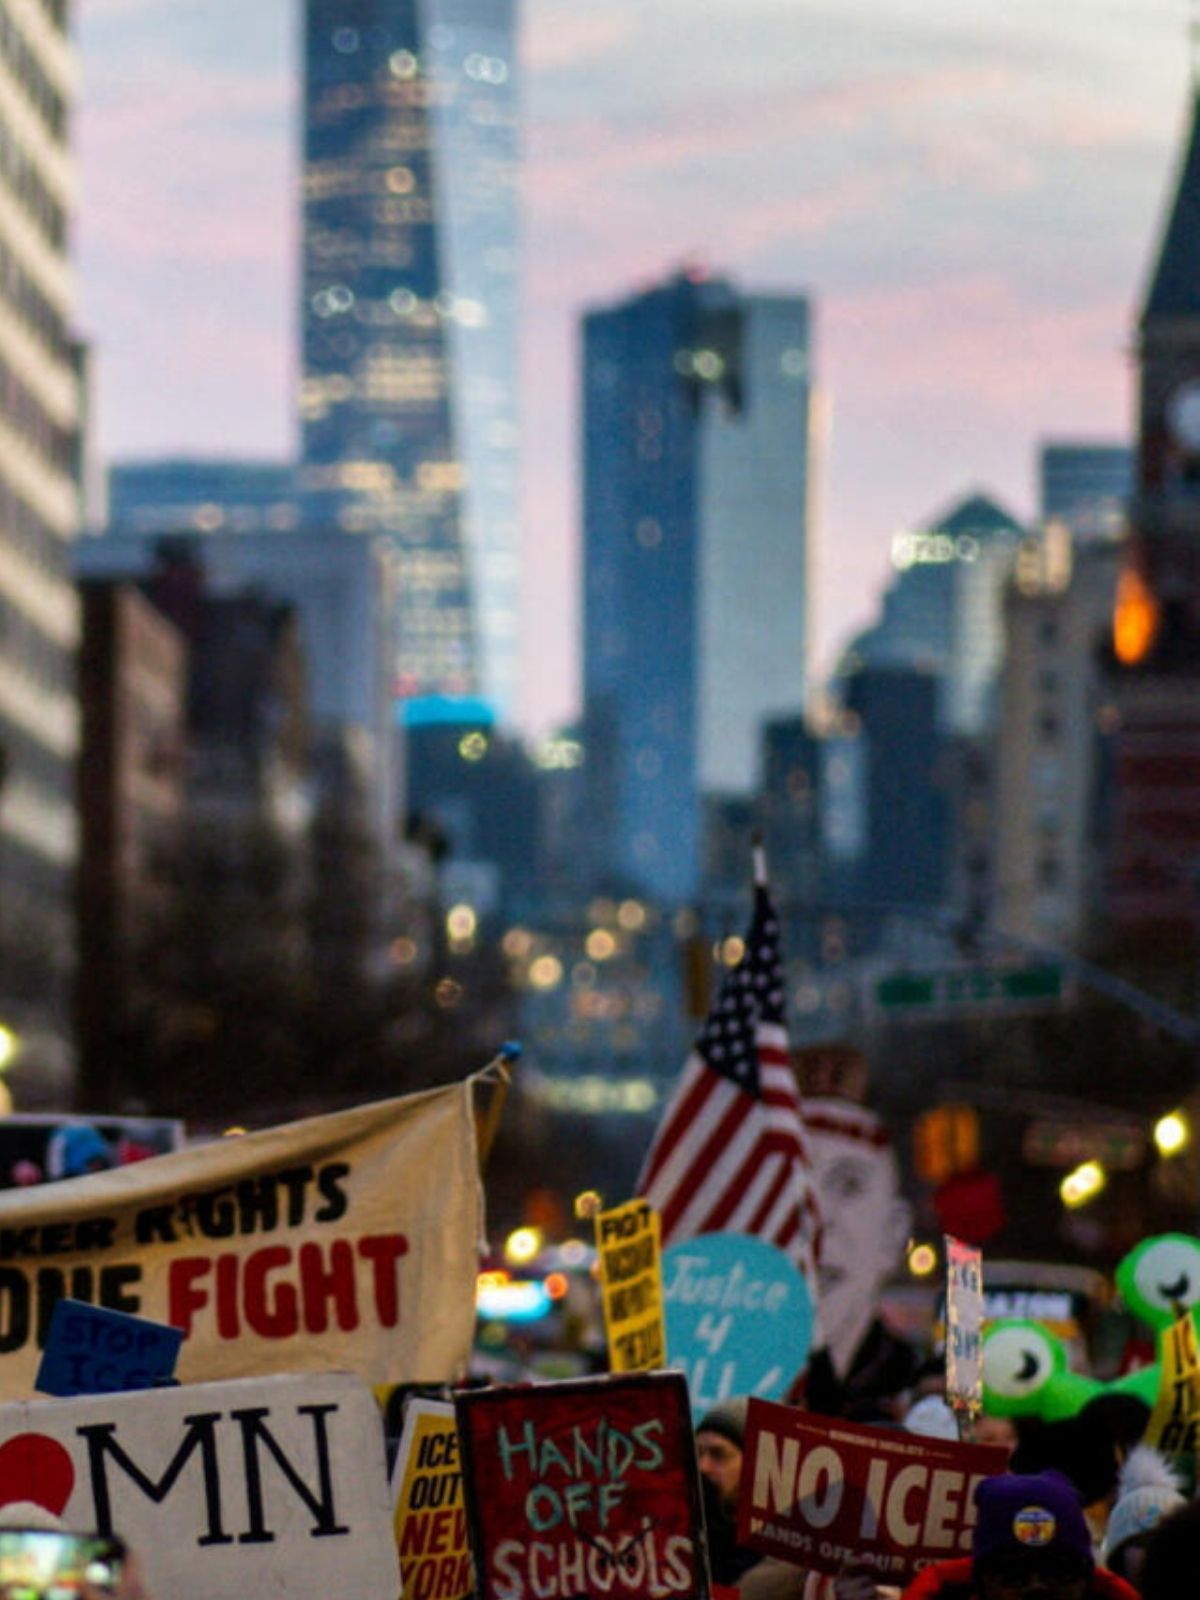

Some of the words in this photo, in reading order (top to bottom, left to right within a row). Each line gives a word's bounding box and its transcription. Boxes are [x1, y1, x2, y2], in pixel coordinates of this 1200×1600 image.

[167, 1234, 409, 1341] FIGHT
[61, 1314, 160, 1359] STOP
[695, 1314, 733, 1354] 4
[76, 1404, 350, 1547] MN
[417, 1432, 459, 1469] ICE
[498, 1418, 666, 1482] HANDS
[409, 1473, 463, 1511] OUT
[526, 1482, 628, 1531] OFF
[753, 1430, 845, 1528] NO
[492, 1517, 693, 1600] SCHOOLS
